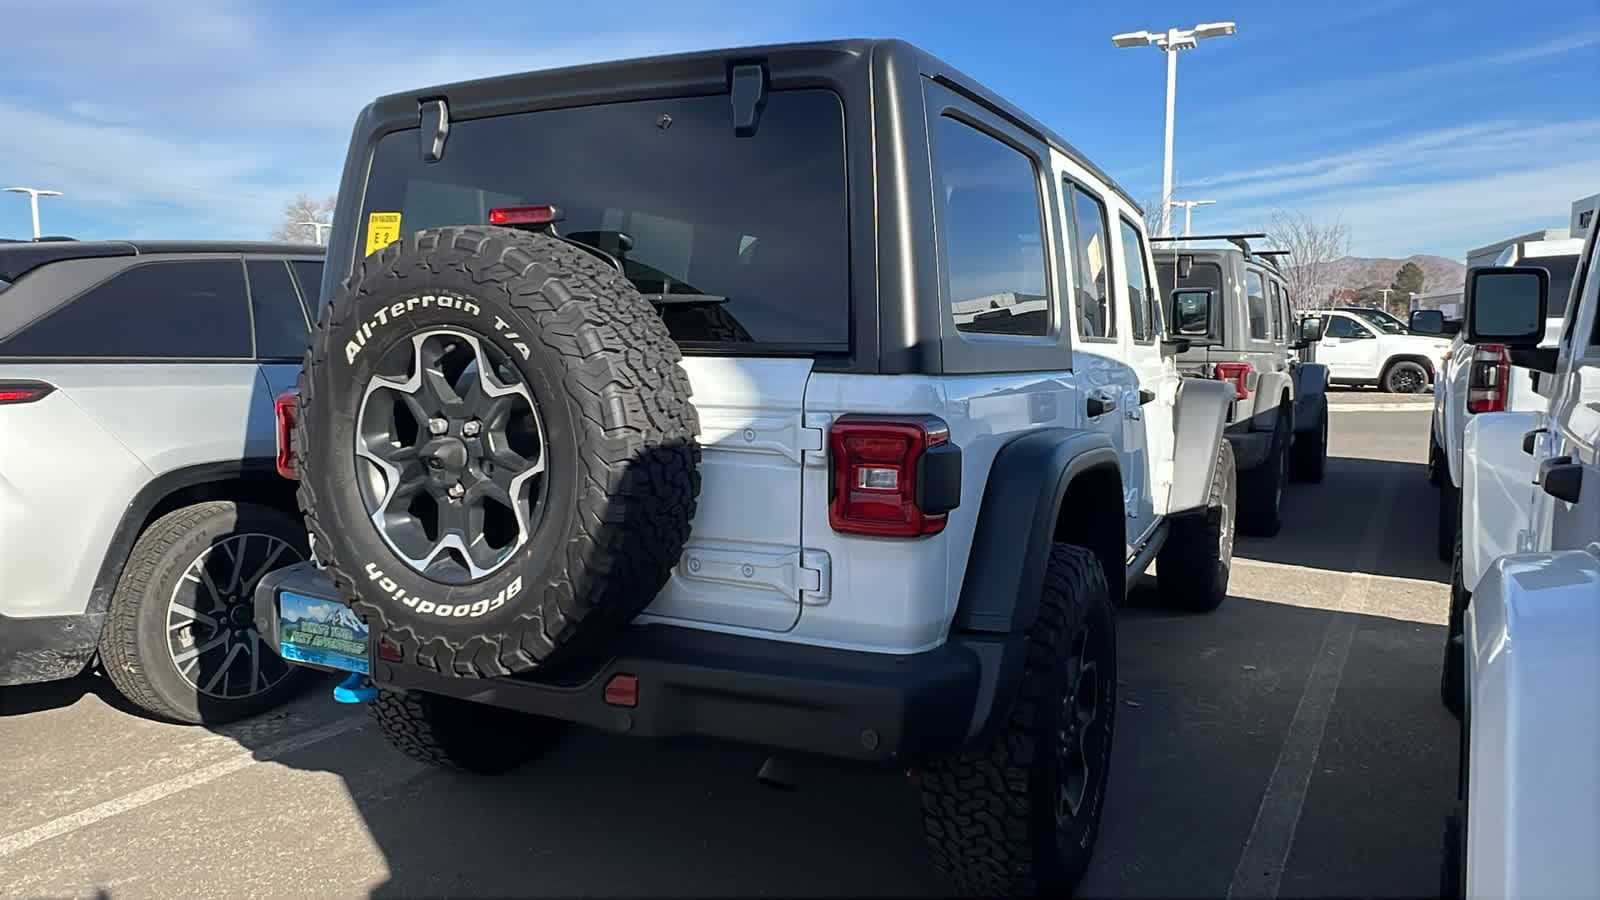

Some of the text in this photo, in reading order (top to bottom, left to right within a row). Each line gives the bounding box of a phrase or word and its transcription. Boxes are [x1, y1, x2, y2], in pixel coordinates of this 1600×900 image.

[345, 295, 531, 365] All-Terrain T/A
[365, 562, 522, 617] BFGoodrich
